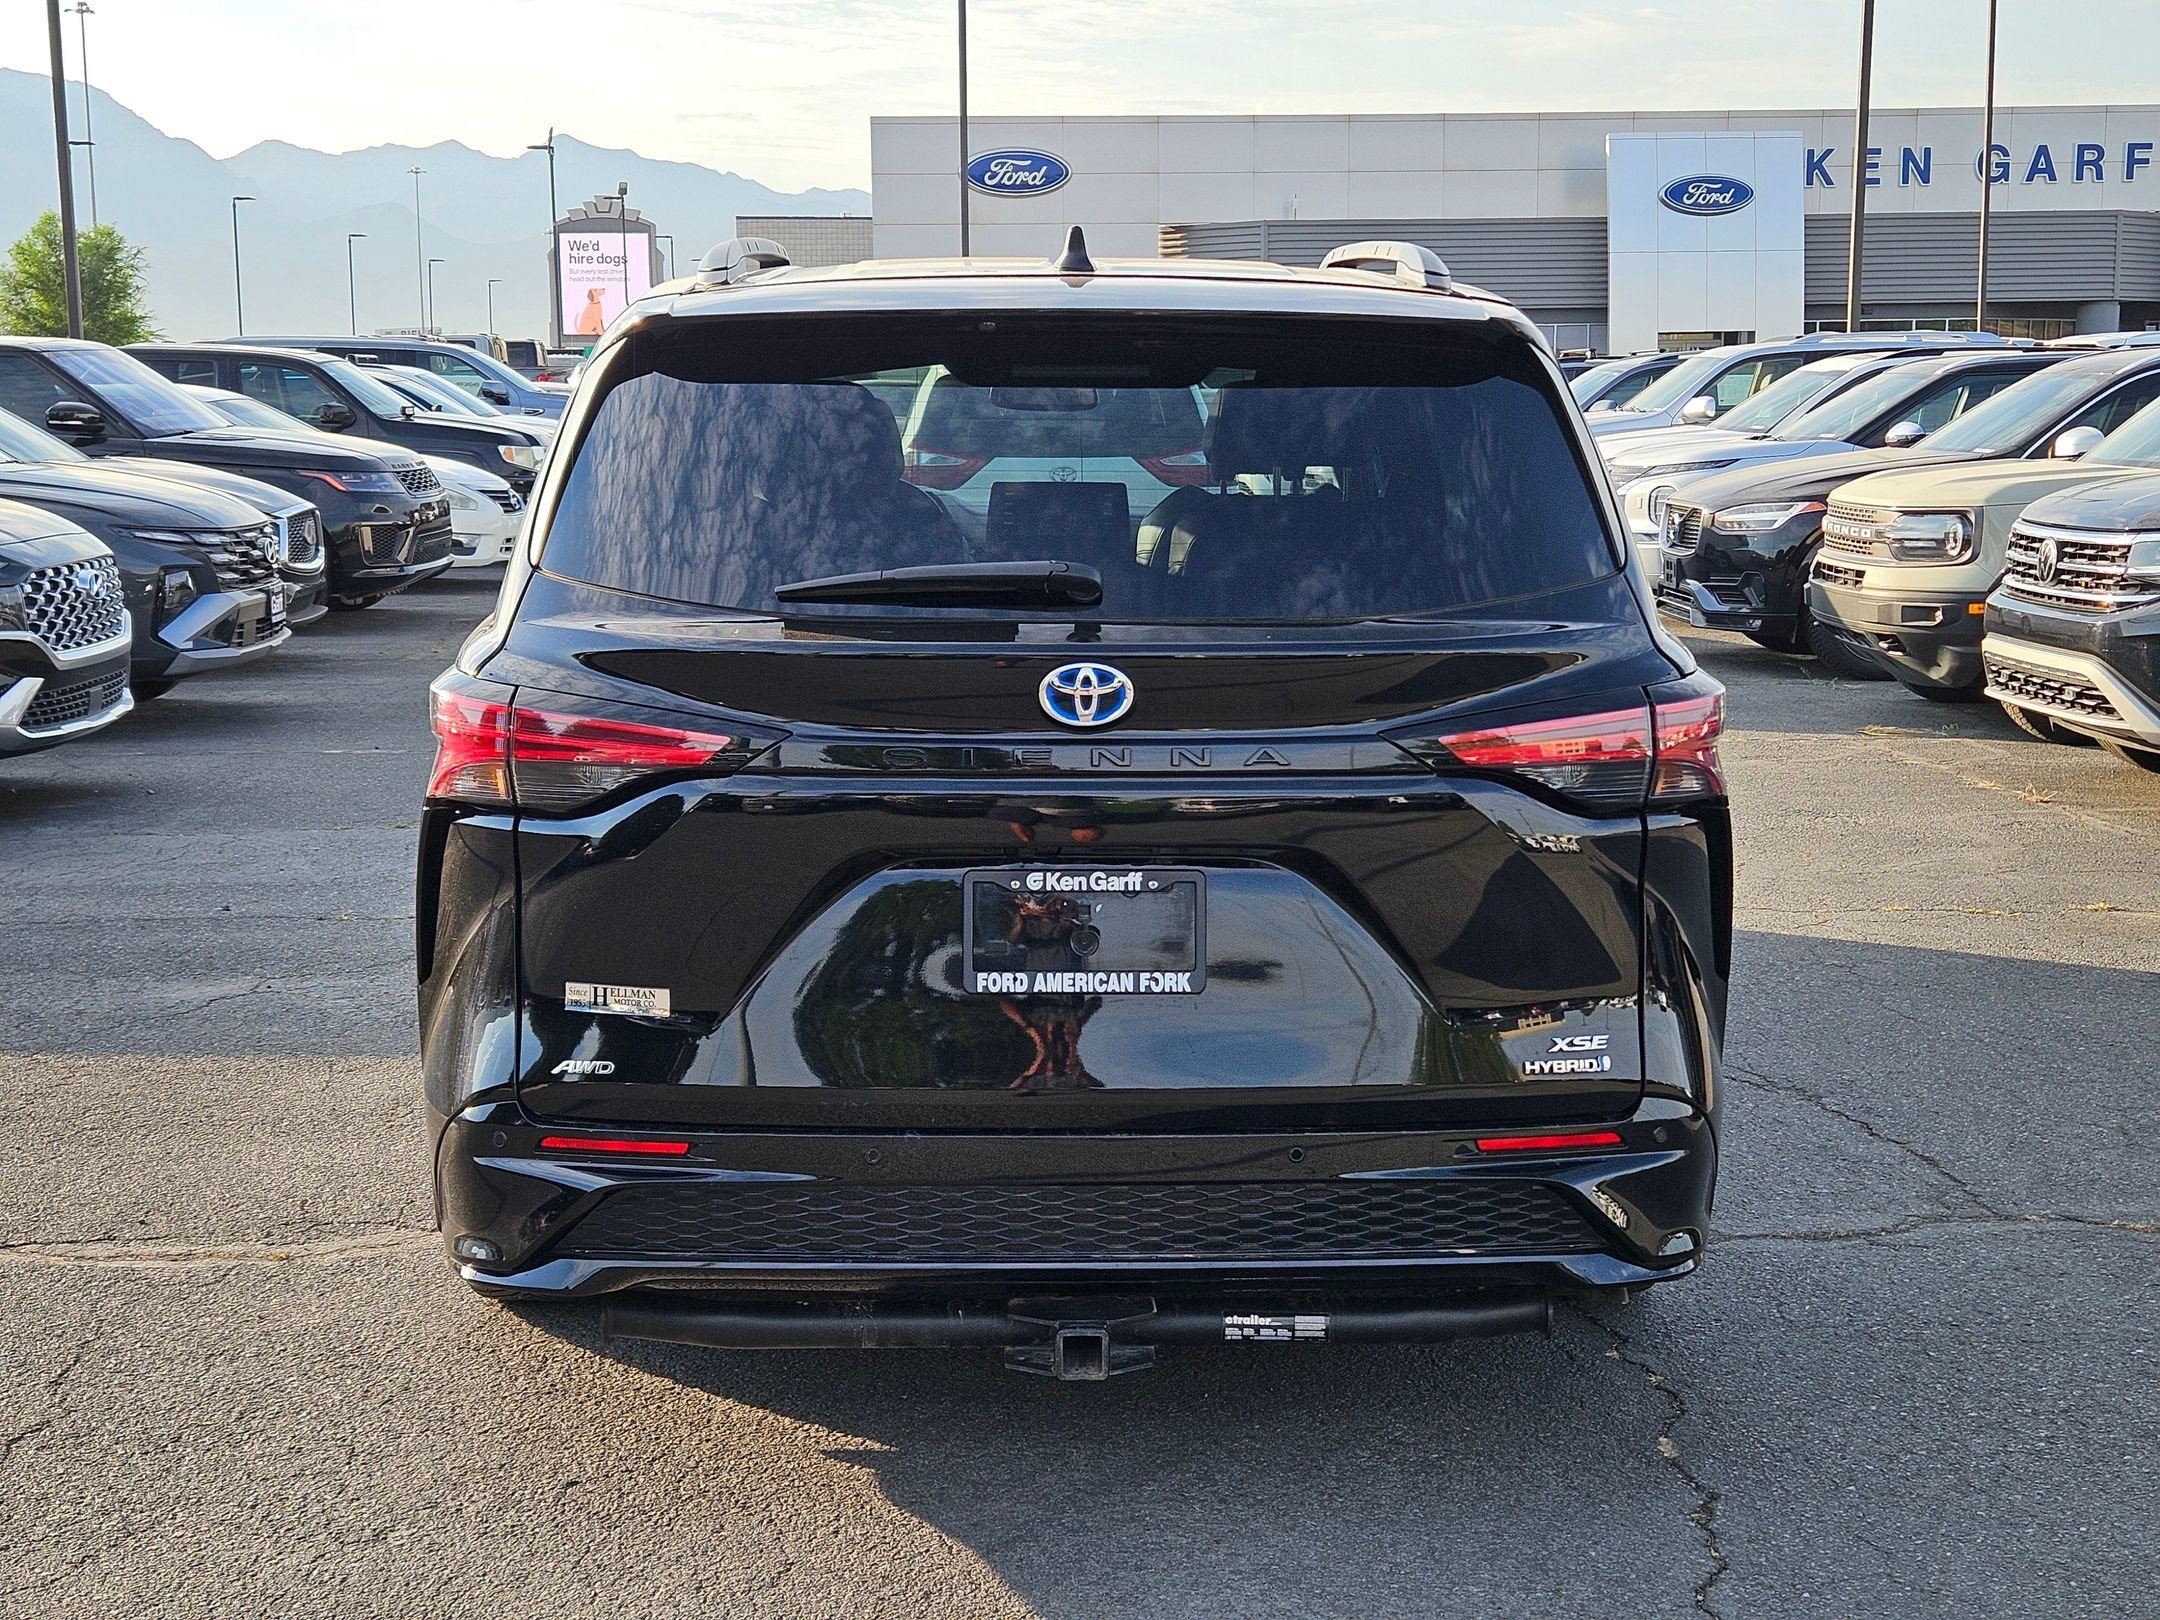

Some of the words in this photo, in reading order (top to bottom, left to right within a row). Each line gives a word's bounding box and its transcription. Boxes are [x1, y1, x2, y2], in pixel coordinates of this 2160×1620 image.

[984, 159, 1048, 185] Ford
[1803, 146, 1933, 188] KEN
[1682, 182, 1735, 204] Ford
[568, 240, 600, 251] We'd
[569, 253, 594, 264] hire
[597, 253, 628, 267] dogs
[882, 746, 1291, 768] SIENNA
[1046, 873, 1087, 891] Ken
[1089, 872, 1143, 891] Garff
[568, 986, 588, 997] Since
[977, 972, 1028, 993] FORD
[1033, 972, 1134, 993] AMERICAN
[1140, 973, 1191, 993] FORK
[592, 986, 657, 1007] HELLMAN
[613, 998, 642, 1007] MOTOR
[643, 1000, 657, 1008] CO.
[1548, 1034, 1610, 1053] XSE
[551, 1060, 615, 1075] AWD
[1524, 1058, 1599, 1075] HYBRID
